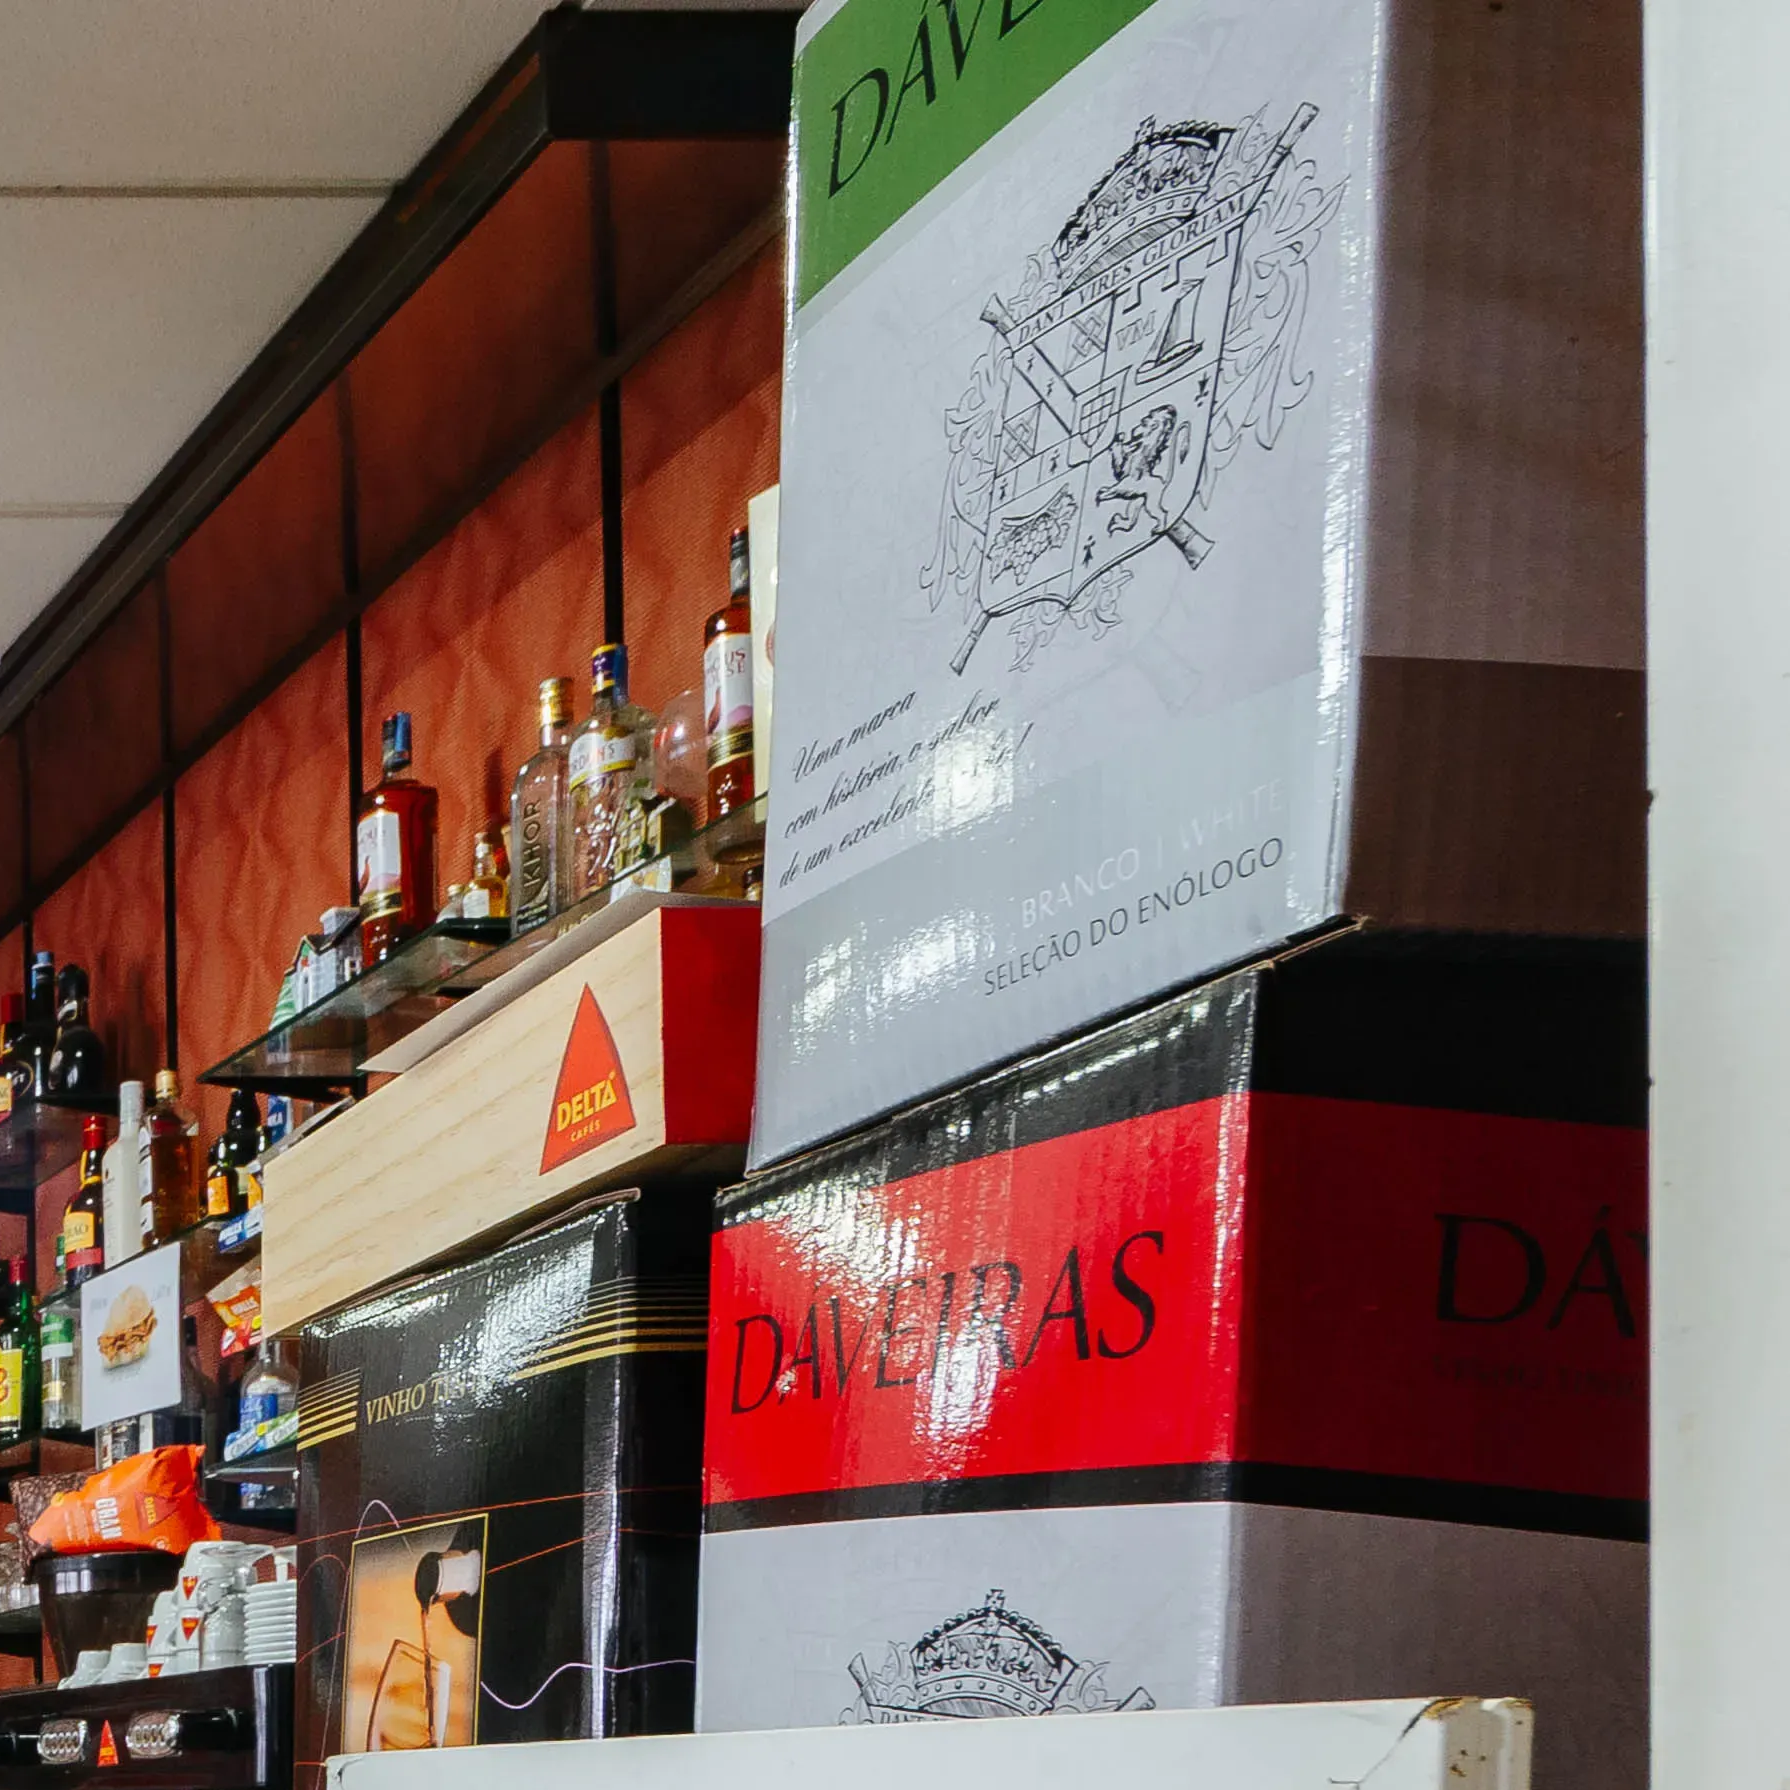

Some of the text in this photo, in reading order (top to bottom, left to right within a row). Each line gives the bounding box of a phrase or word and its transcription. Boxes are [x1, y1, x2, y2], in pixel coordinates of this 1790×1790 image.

[1077, 260, 1132, 305] VIRES
[1141, 194, 1247, 268] GLORIAM
[982, 836, 1285, 997] SELEÇÃO DO ENÓLOGO
[1020, 846, 1141, 931] BRANCO
[556, 1079, 618, 1132] DELTA
[366, 1383, 427, 1425] VINHO
